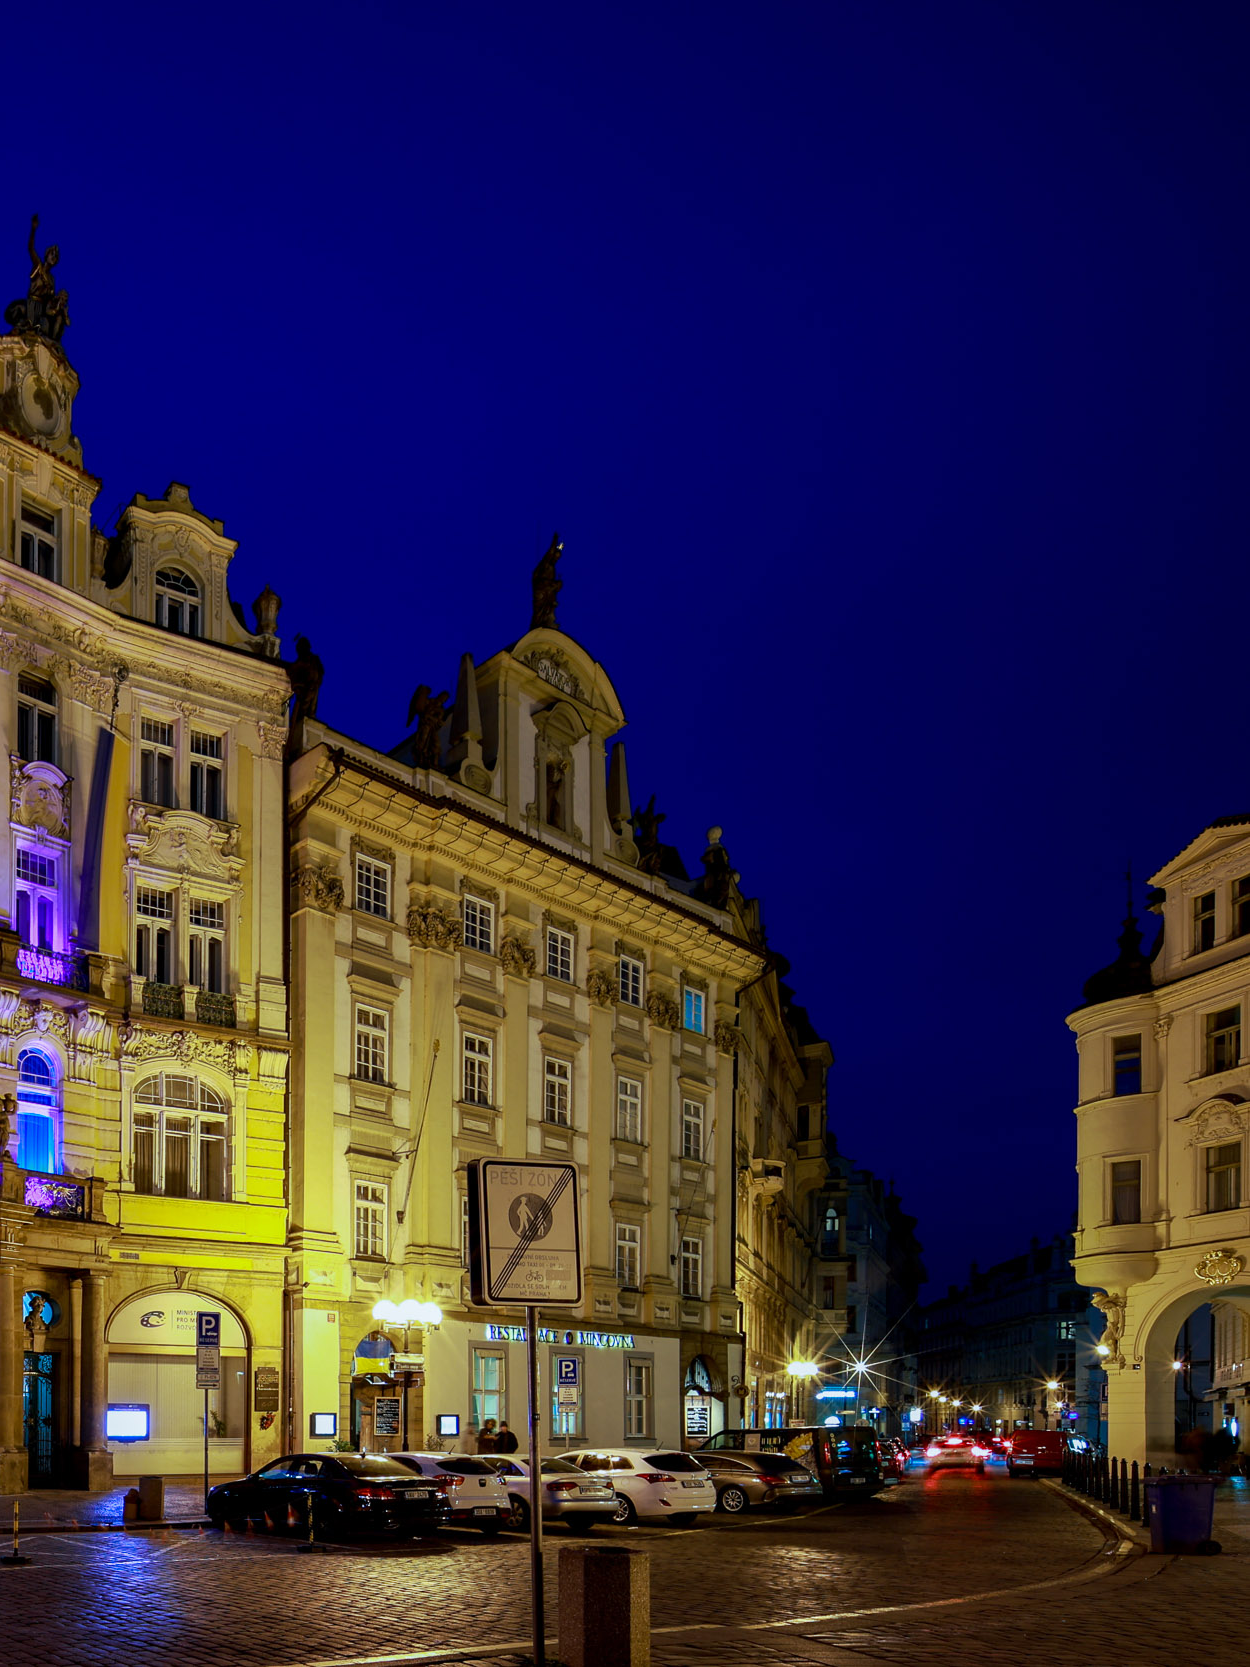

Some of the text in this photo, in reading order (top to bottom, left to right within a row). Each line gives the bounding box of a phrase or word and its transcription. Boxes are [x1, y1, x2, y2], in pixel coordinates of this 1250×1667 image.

[490, 1167, 558, 1187] PĚŠÍ ZÓN
[202, 1316, 216, 1336] P
[490, 1324, 635, 1349] RESTAACE MINCOVNA
[561, 1361, 574, 1377] P
